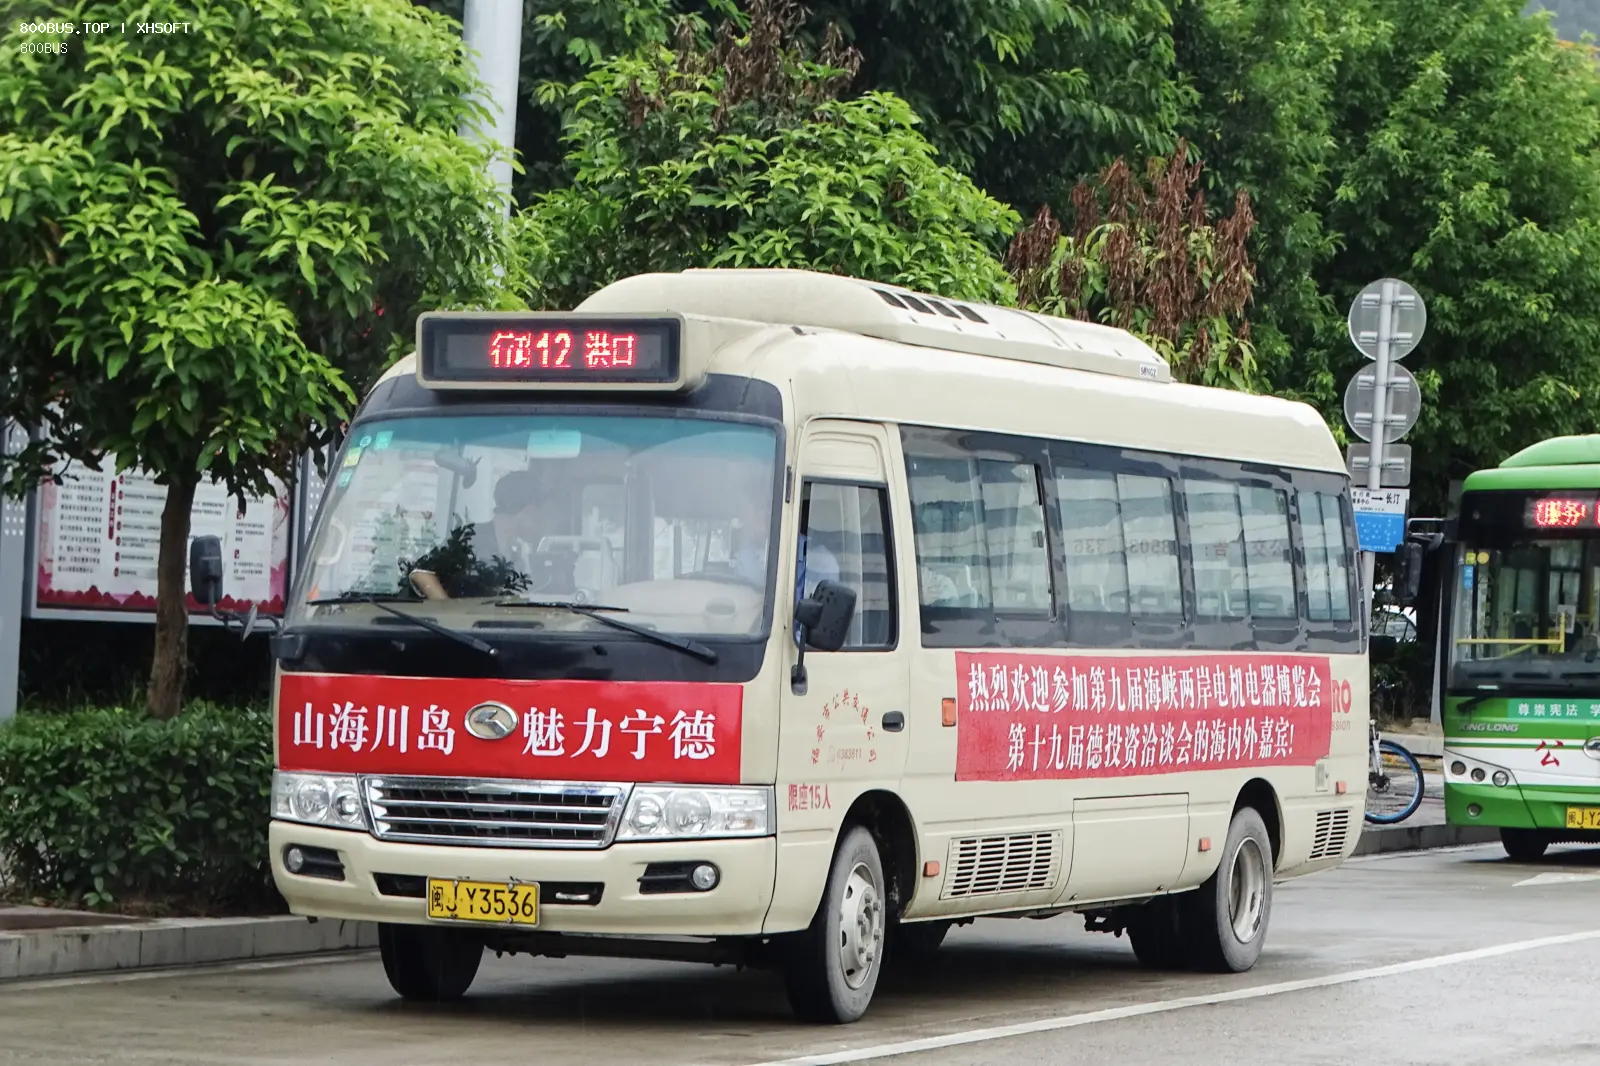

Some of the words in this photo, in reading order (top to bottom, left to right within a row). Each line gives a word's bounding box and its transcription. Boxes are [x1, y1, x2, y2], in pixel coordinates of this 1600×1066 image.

[968, 662, 1322, 714] 热烈欢迎参加第九届海峡两岸电机电器博览会
[1518, 703, 1578, 717] 尊崇宪法
[292, 701, 456, 756] 山海川岛
[521, 705, 717, 760] 魅力宁德
[1535, 740, 1564, 767] 公
[788, 783, 831, 811] 限座15人
